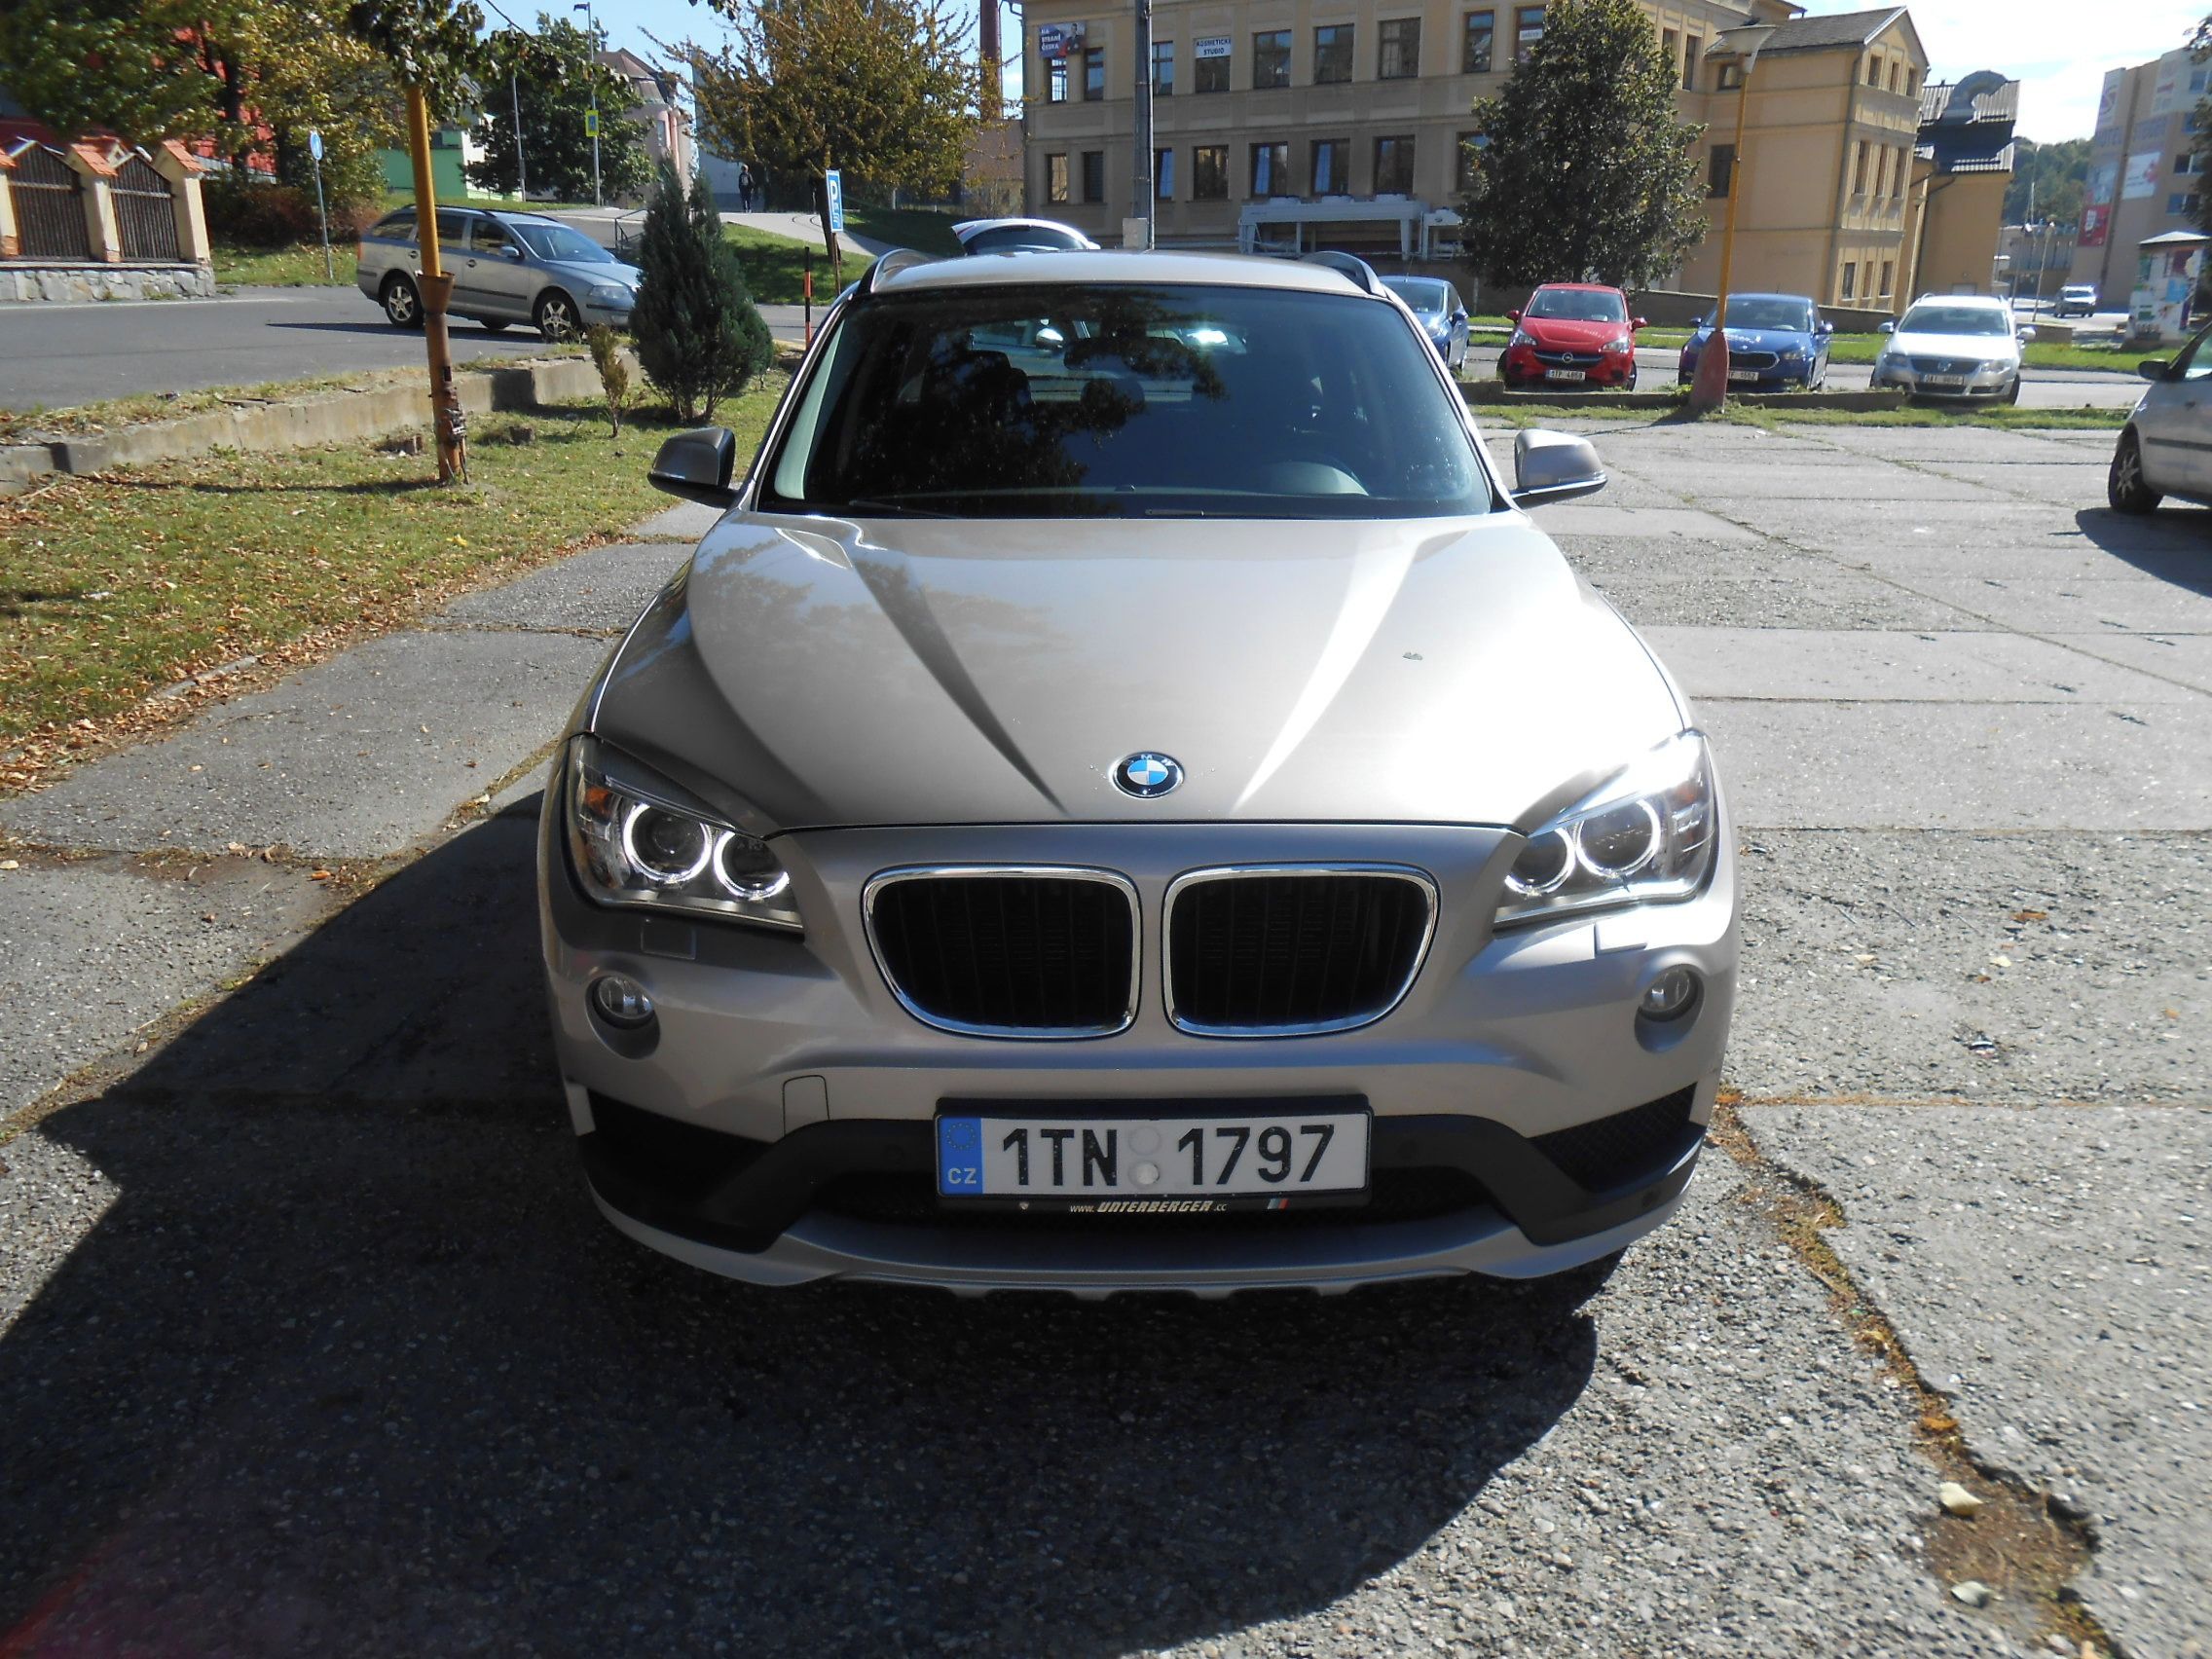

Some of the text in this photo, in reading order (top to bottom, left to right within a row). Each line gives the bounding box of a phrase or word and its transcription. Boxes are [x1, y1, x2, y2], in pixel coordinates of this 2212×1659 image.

[1203, 47, 1225, 55] STUDIO
[1003, 1124, 1335, 1186] 1TN 1797
[947, 1167, 977, 1185] CZ
